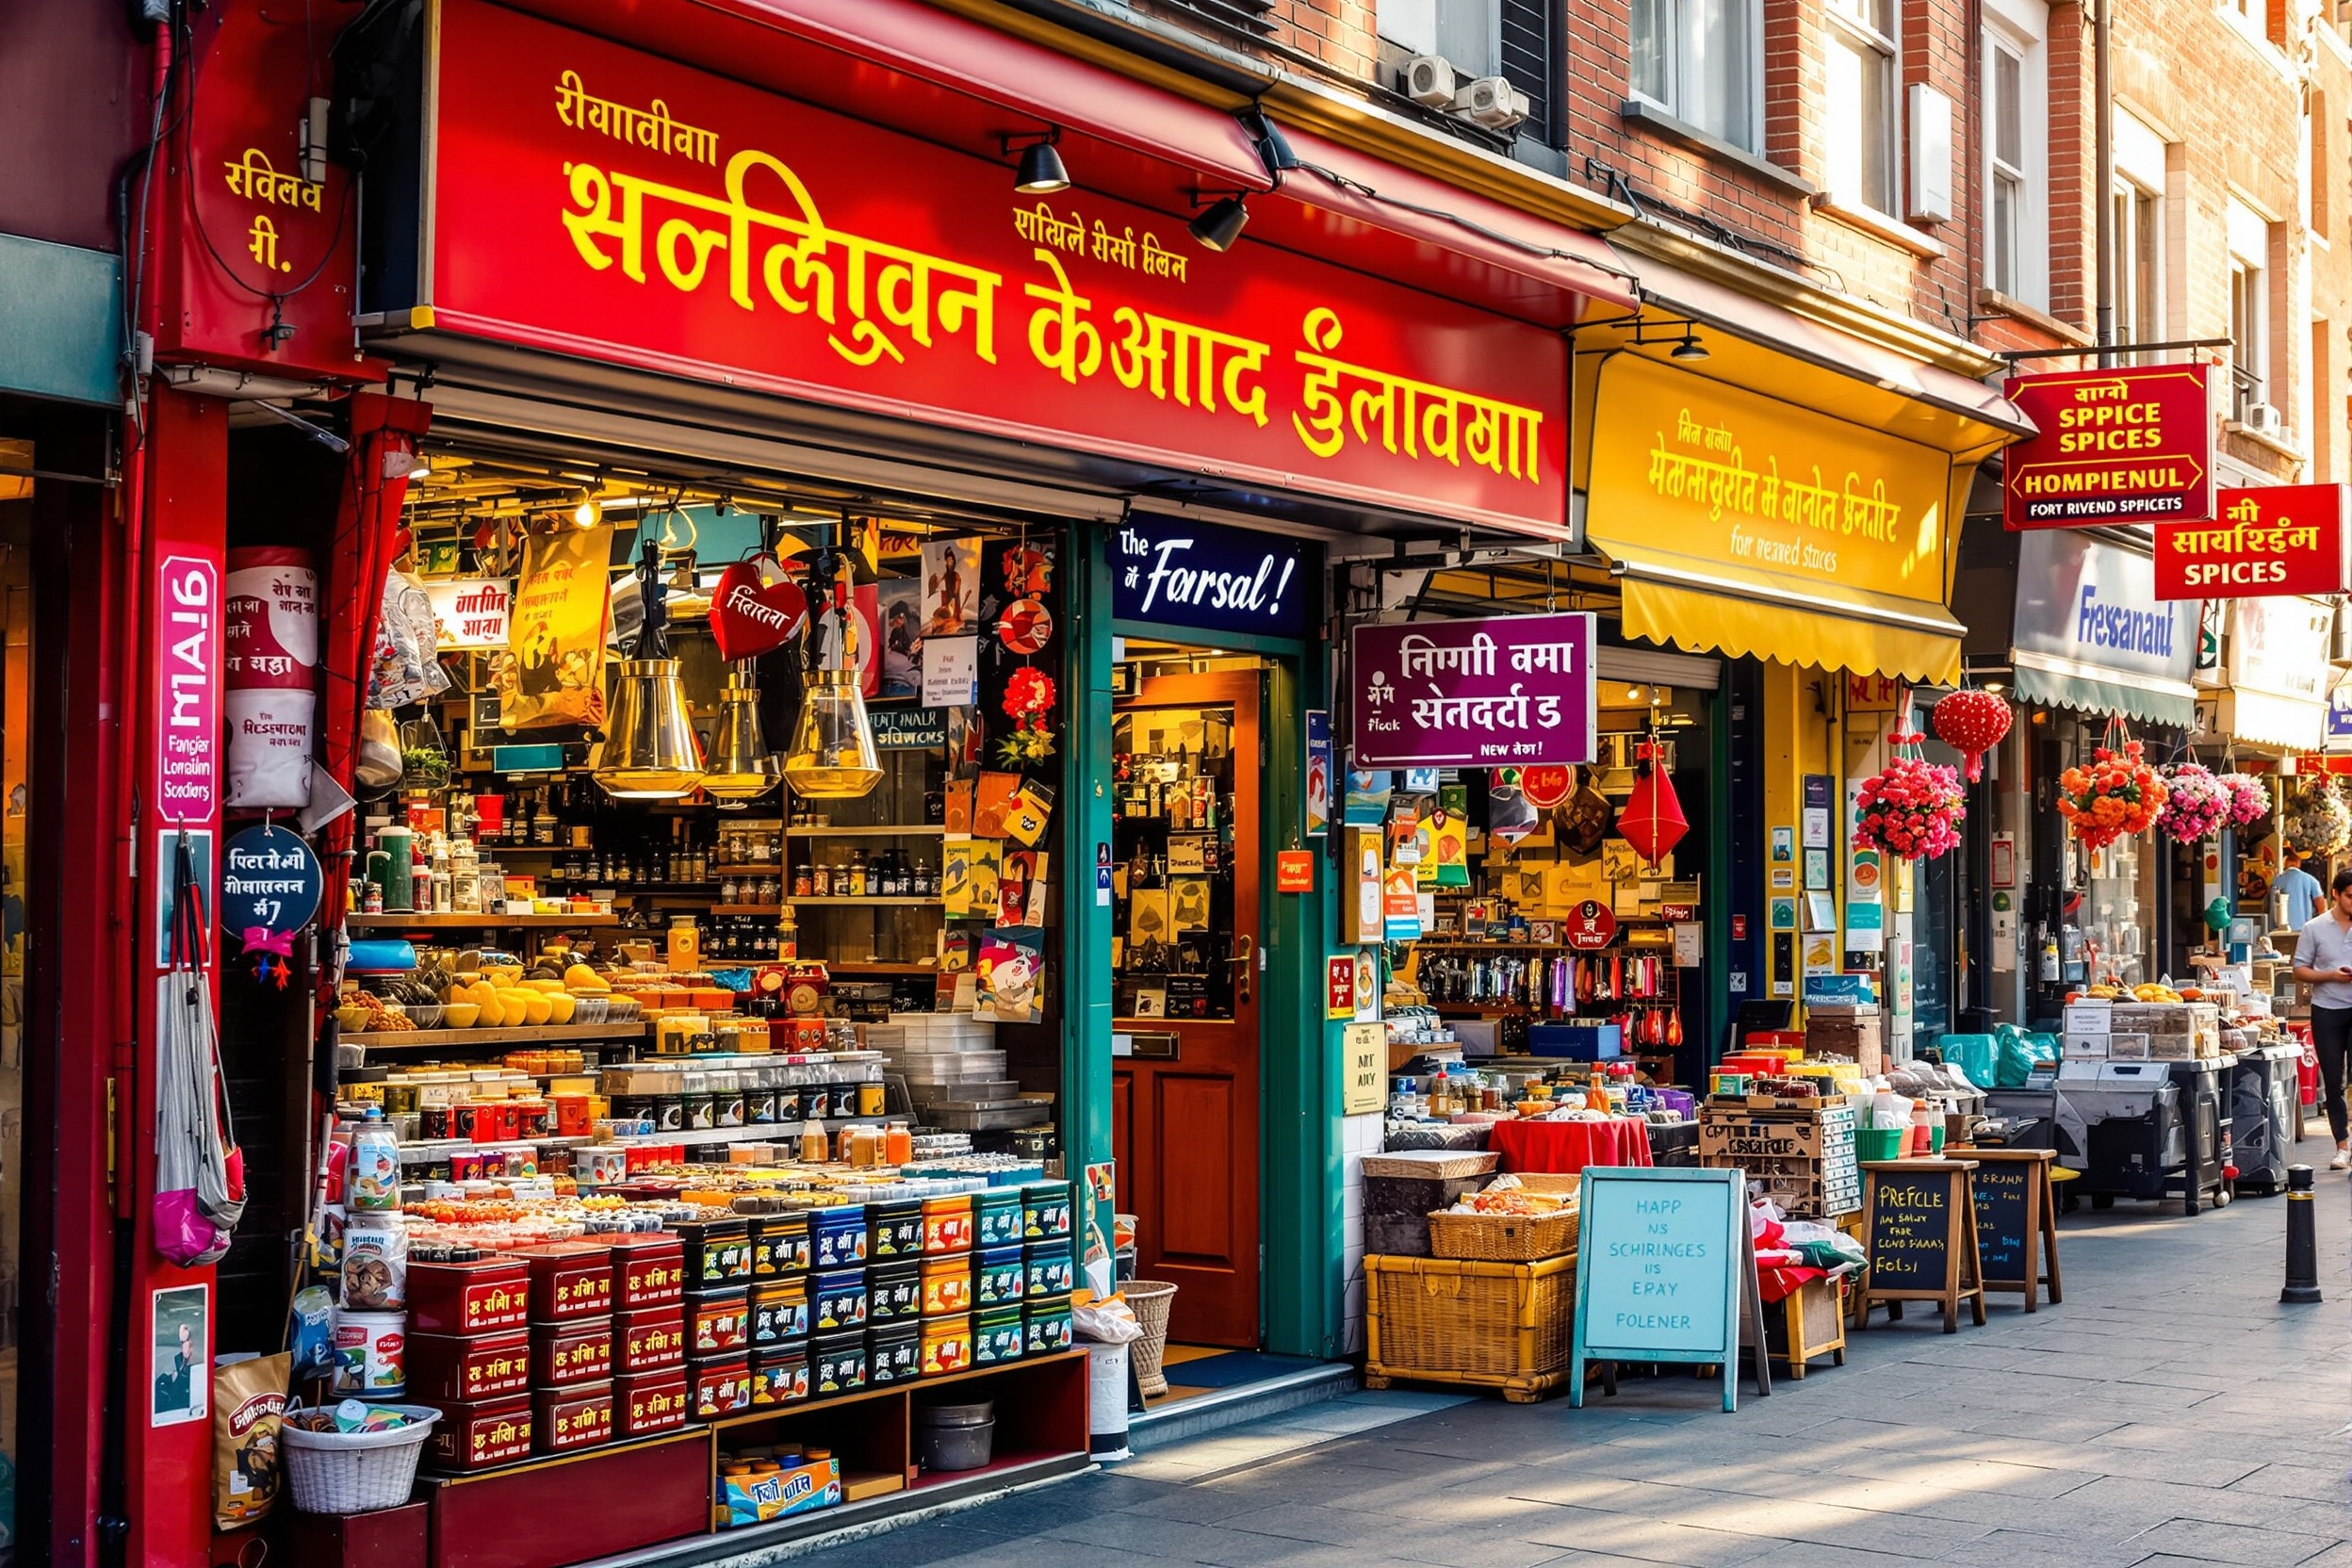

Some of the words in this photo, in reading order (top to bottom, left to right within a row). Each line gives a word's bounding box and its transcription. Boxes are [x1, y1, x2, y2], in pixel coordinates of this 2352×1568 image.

[2059, 402, 2162, 428] SPPICE
[2060, 428, 2163, 452] SPICES
[2025, 467, 2184, 494] HOMPIENUL
[2066, 500, 2116, 514] RIVEND
[1119, 528, 1149, 556] The
[2184, 561, 2287, 585] SPICES
[1480, 743, 1509, 756] NEW
[1636, 1200, 1682, 1215] HAPP
